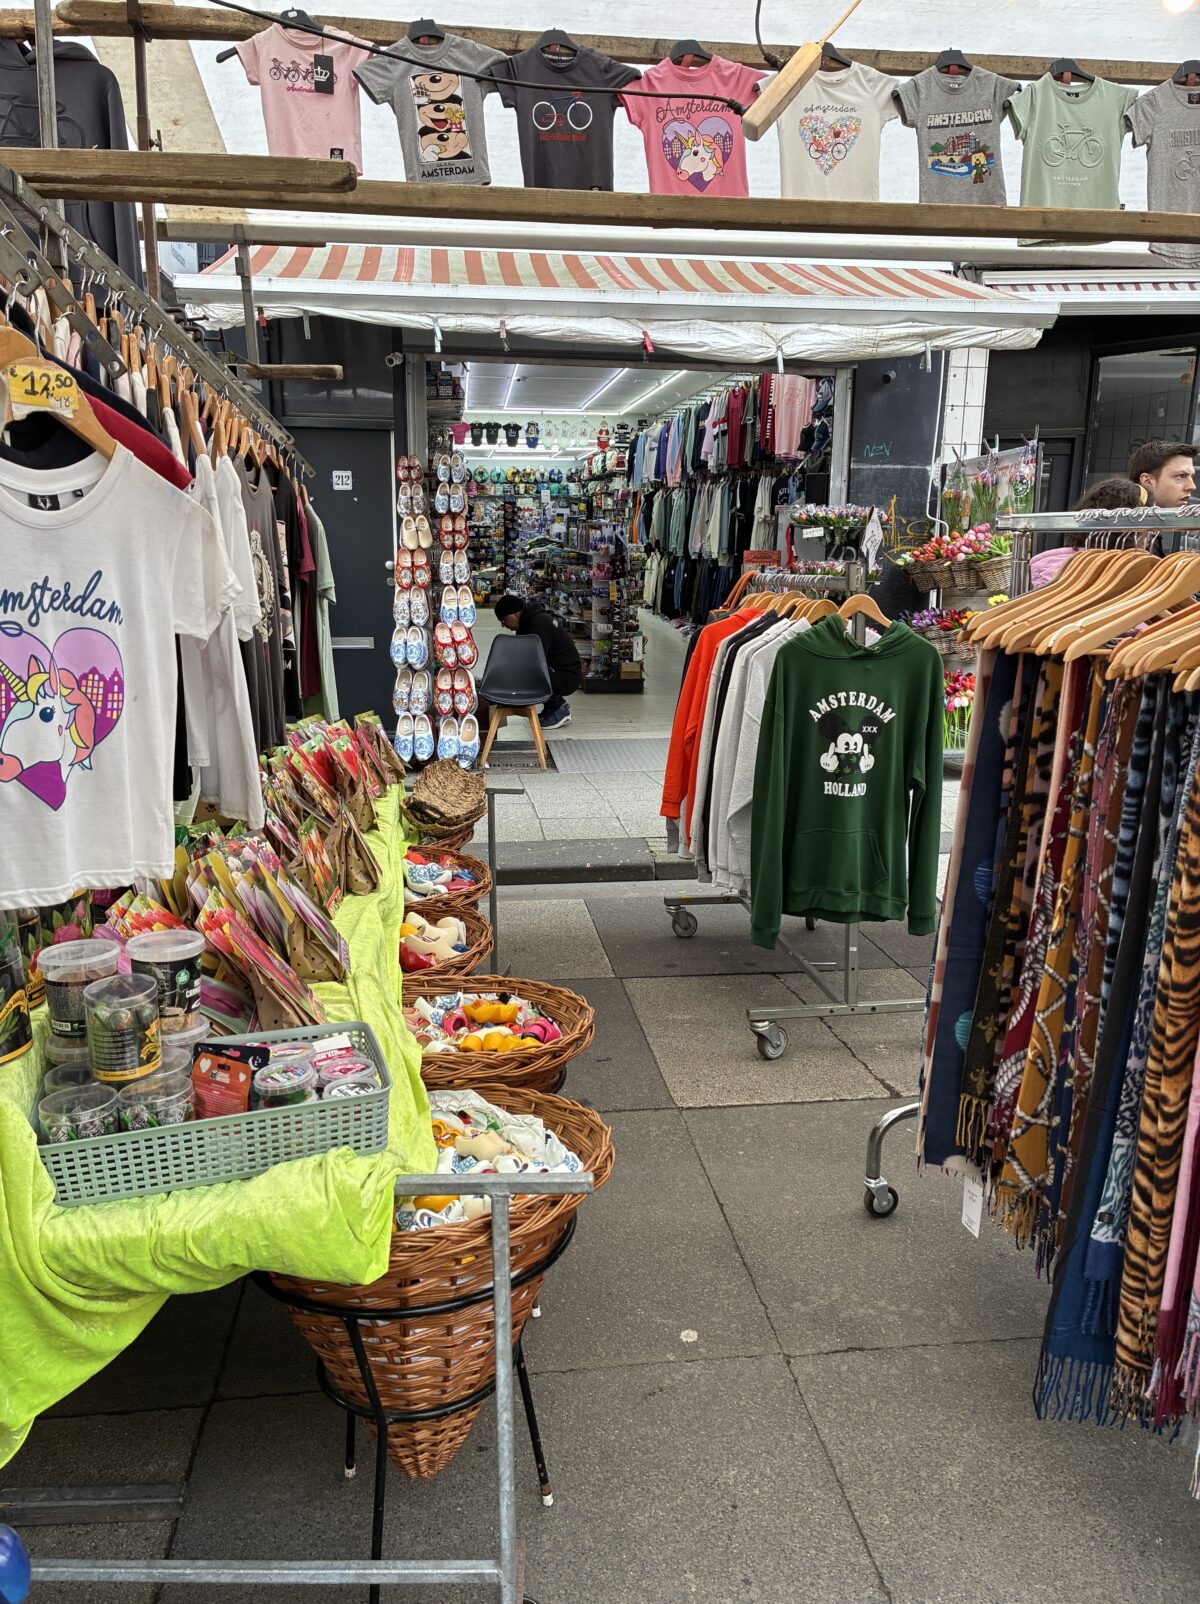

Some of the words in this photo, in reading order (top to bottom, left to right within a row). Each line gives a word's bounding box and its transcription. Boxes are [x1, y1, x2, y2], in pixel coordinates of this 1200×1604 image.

[286, 82, 315, 94] Amsterda
[655, 93, 733, 123] Amsterdam
[803, 103, 858, 115] Amsterdam
[926, 108, 993, 130] AMSTERDAM
[421, 165, 475, 179] AMSTERDAM
[9, 365, 18, 378] €
[335, 474, 350, 486] 212
[611, 629, 620, 663] MINIS
[808, 691, 897, 724] AMSTERDAM
[861, 725, 878, 734] XXX
[823, 781, 867, 797] HOLLAND
